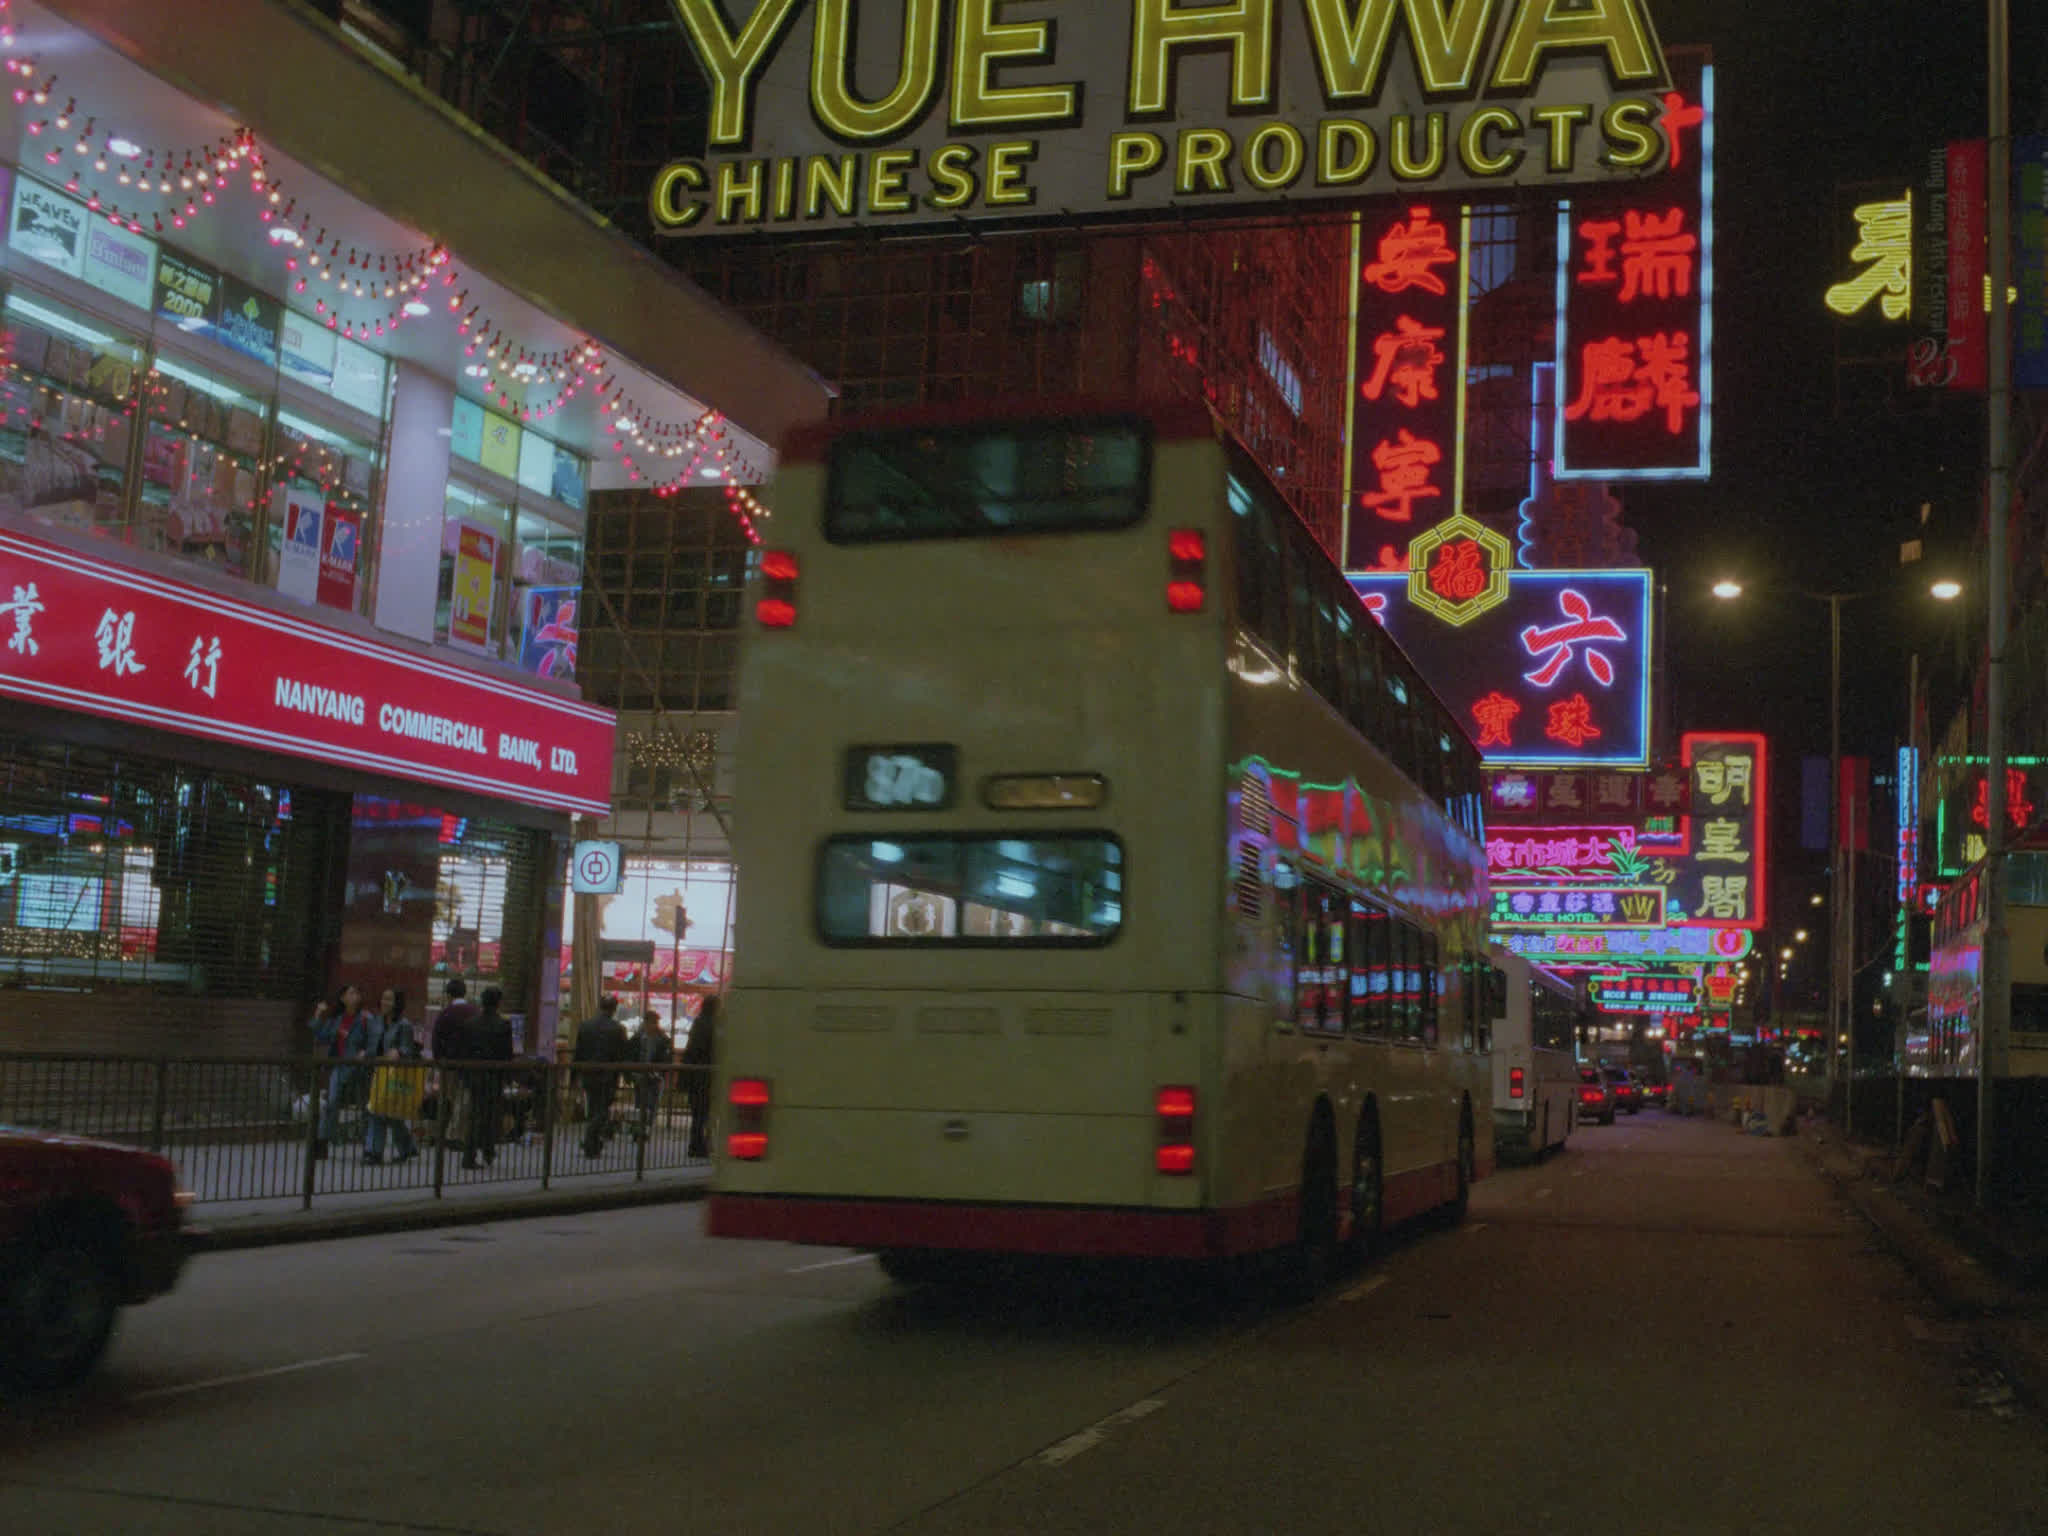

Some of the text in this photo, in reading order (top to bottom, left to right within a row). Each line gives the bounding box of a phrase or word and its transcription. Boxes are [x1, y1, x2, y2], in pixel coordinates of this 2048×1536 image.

[674, 0, 1075, 145] YUE
[653, 98, 1664, 227] CHINESE PRODUCTS
[1521, 588, 1628, 688] 六
[275, 676, 579, 776] NANYANG COMMERCIAL BANK, LTD.
[1504, 912, 1553, 922] PALACE
[1557, 912, 1600, 923] HOTEL
